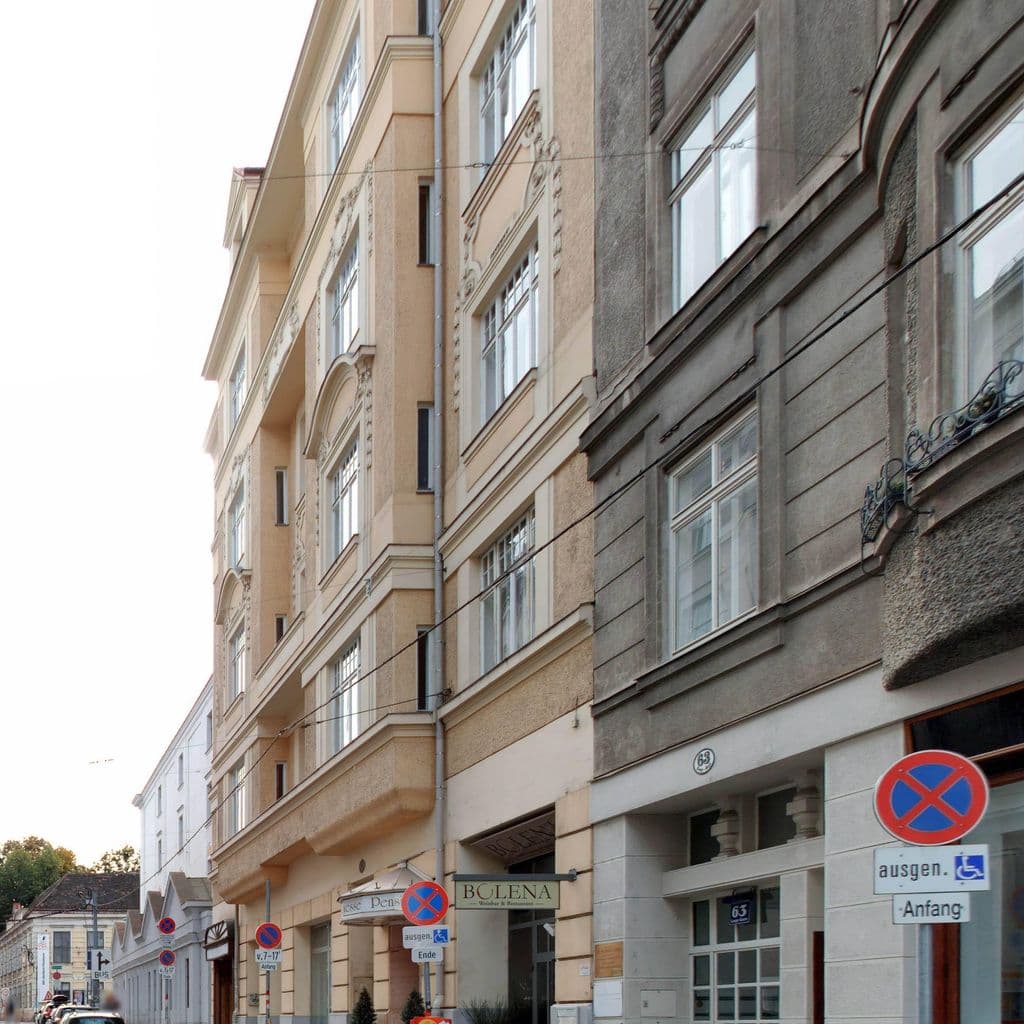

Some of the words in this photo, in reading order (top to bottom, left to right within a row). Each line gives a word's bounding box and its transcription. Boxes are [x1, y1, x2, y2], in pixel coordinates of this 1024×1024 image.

[697, 750, 712, 767] 63
[878, 862, 948, 881] ausgen.
[463, 882, 551, 900] BOLENA
[731, 903, 747, 918] 63
[902, 900, 962, 920] Anfang
[404, 932, 433, 943] ausgen.
[418, 950, 437, 960] Ende
